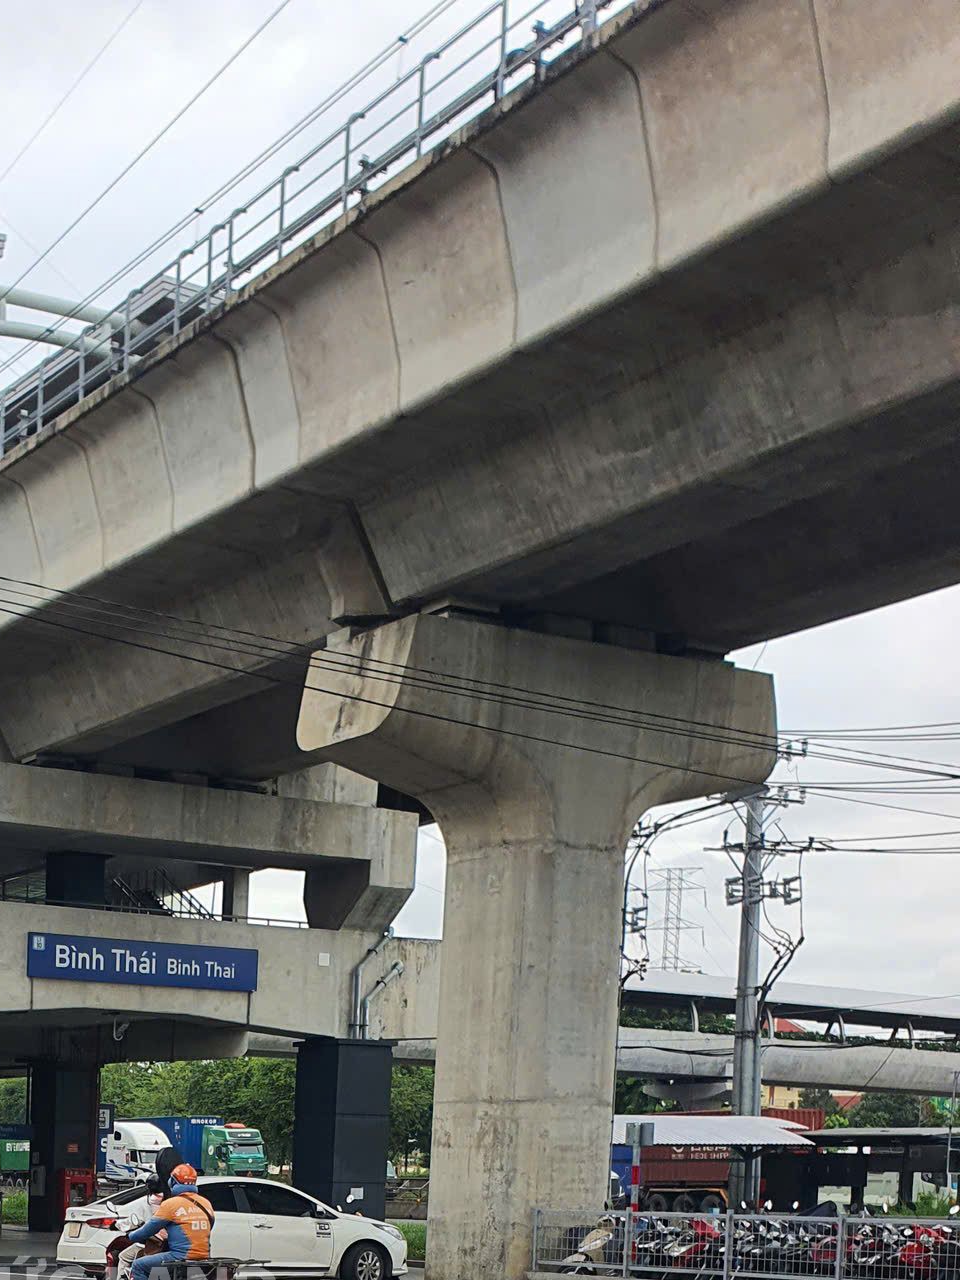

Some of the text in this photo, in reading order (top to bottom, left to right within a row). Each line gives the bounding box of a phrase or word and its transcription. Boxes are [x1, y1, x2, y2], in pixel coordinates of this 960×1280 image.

[55, 944, 235, 979] Bình Thái Binh Thai
